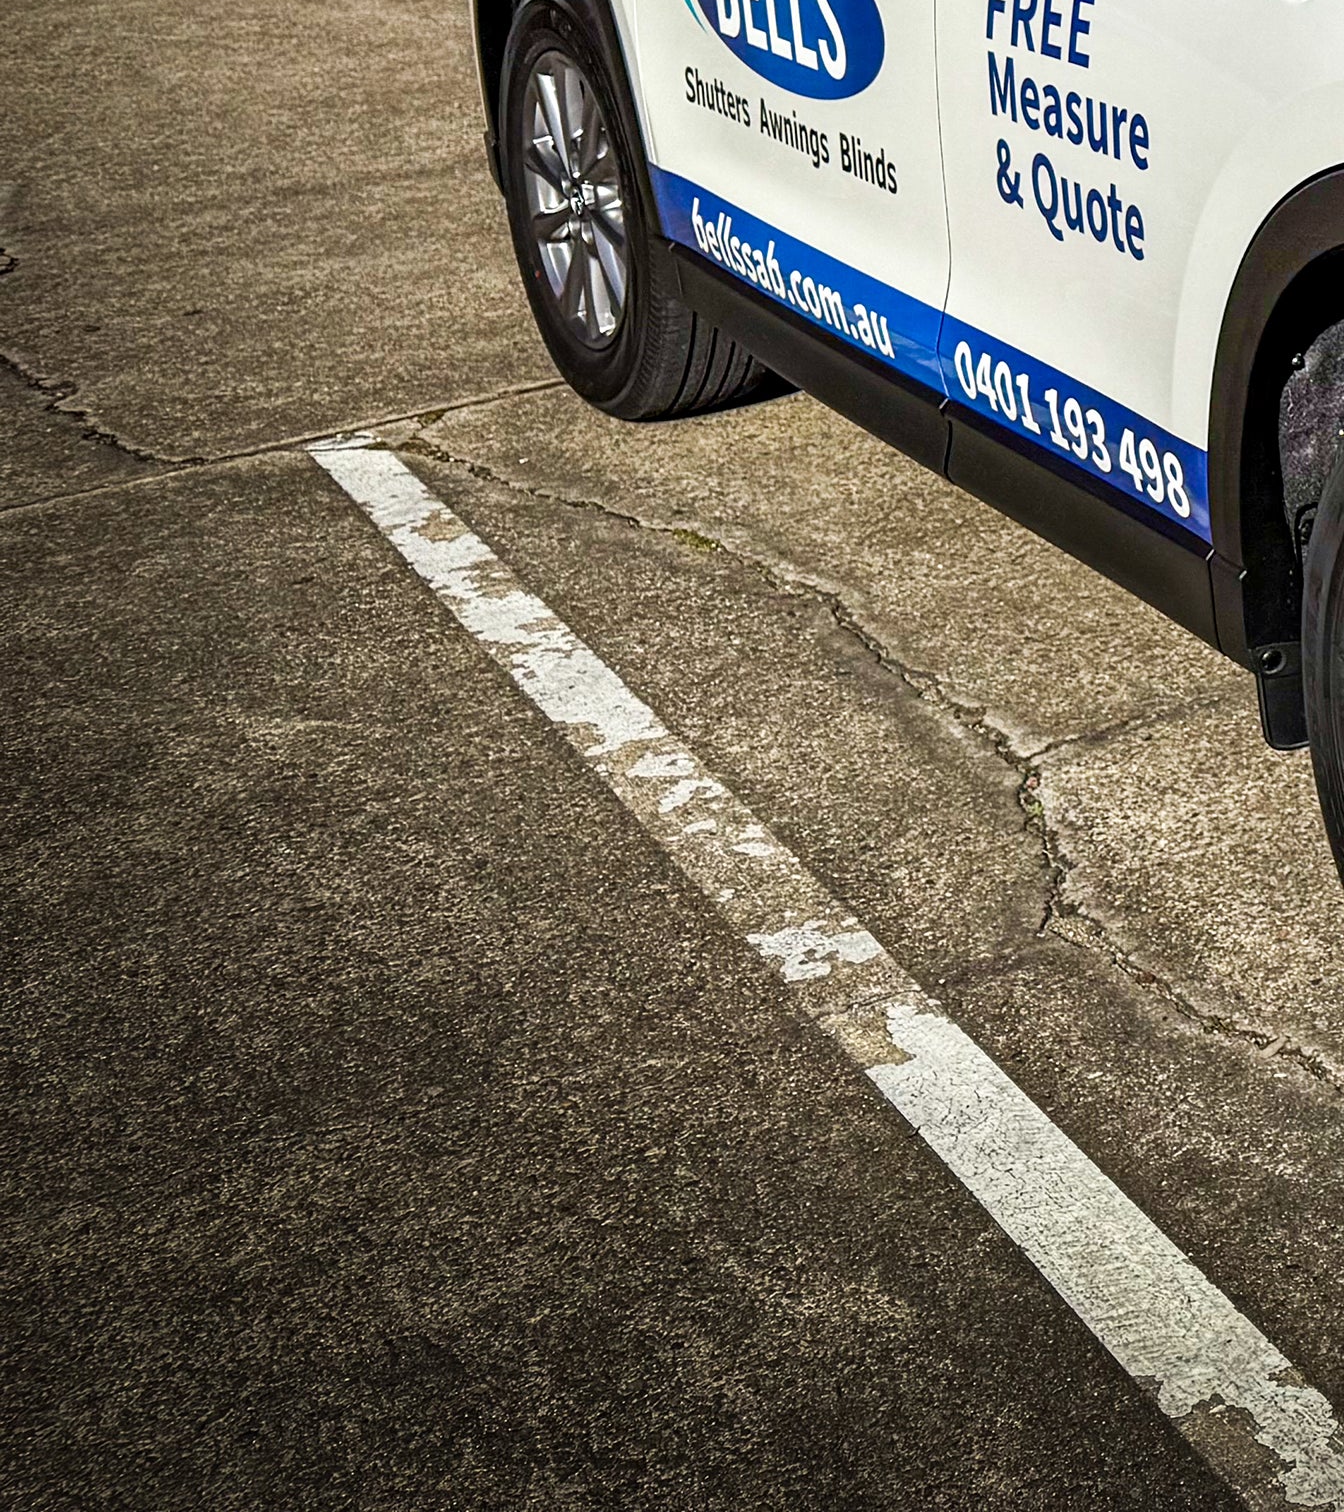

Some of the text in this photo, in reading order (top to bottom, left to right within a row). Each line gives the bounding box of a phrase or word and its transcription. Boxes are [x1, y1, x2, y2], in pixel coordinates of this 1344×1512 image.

[684, 66, 898, 195] Shutters Awnings Blinds
[987, 50, 1149, 171] Measure
[996, 137, 1145, 262] & Quote
[691, 197, 896, 359] bellssab.com.au
[953, 341, 1192, 519] 0401 193 498
